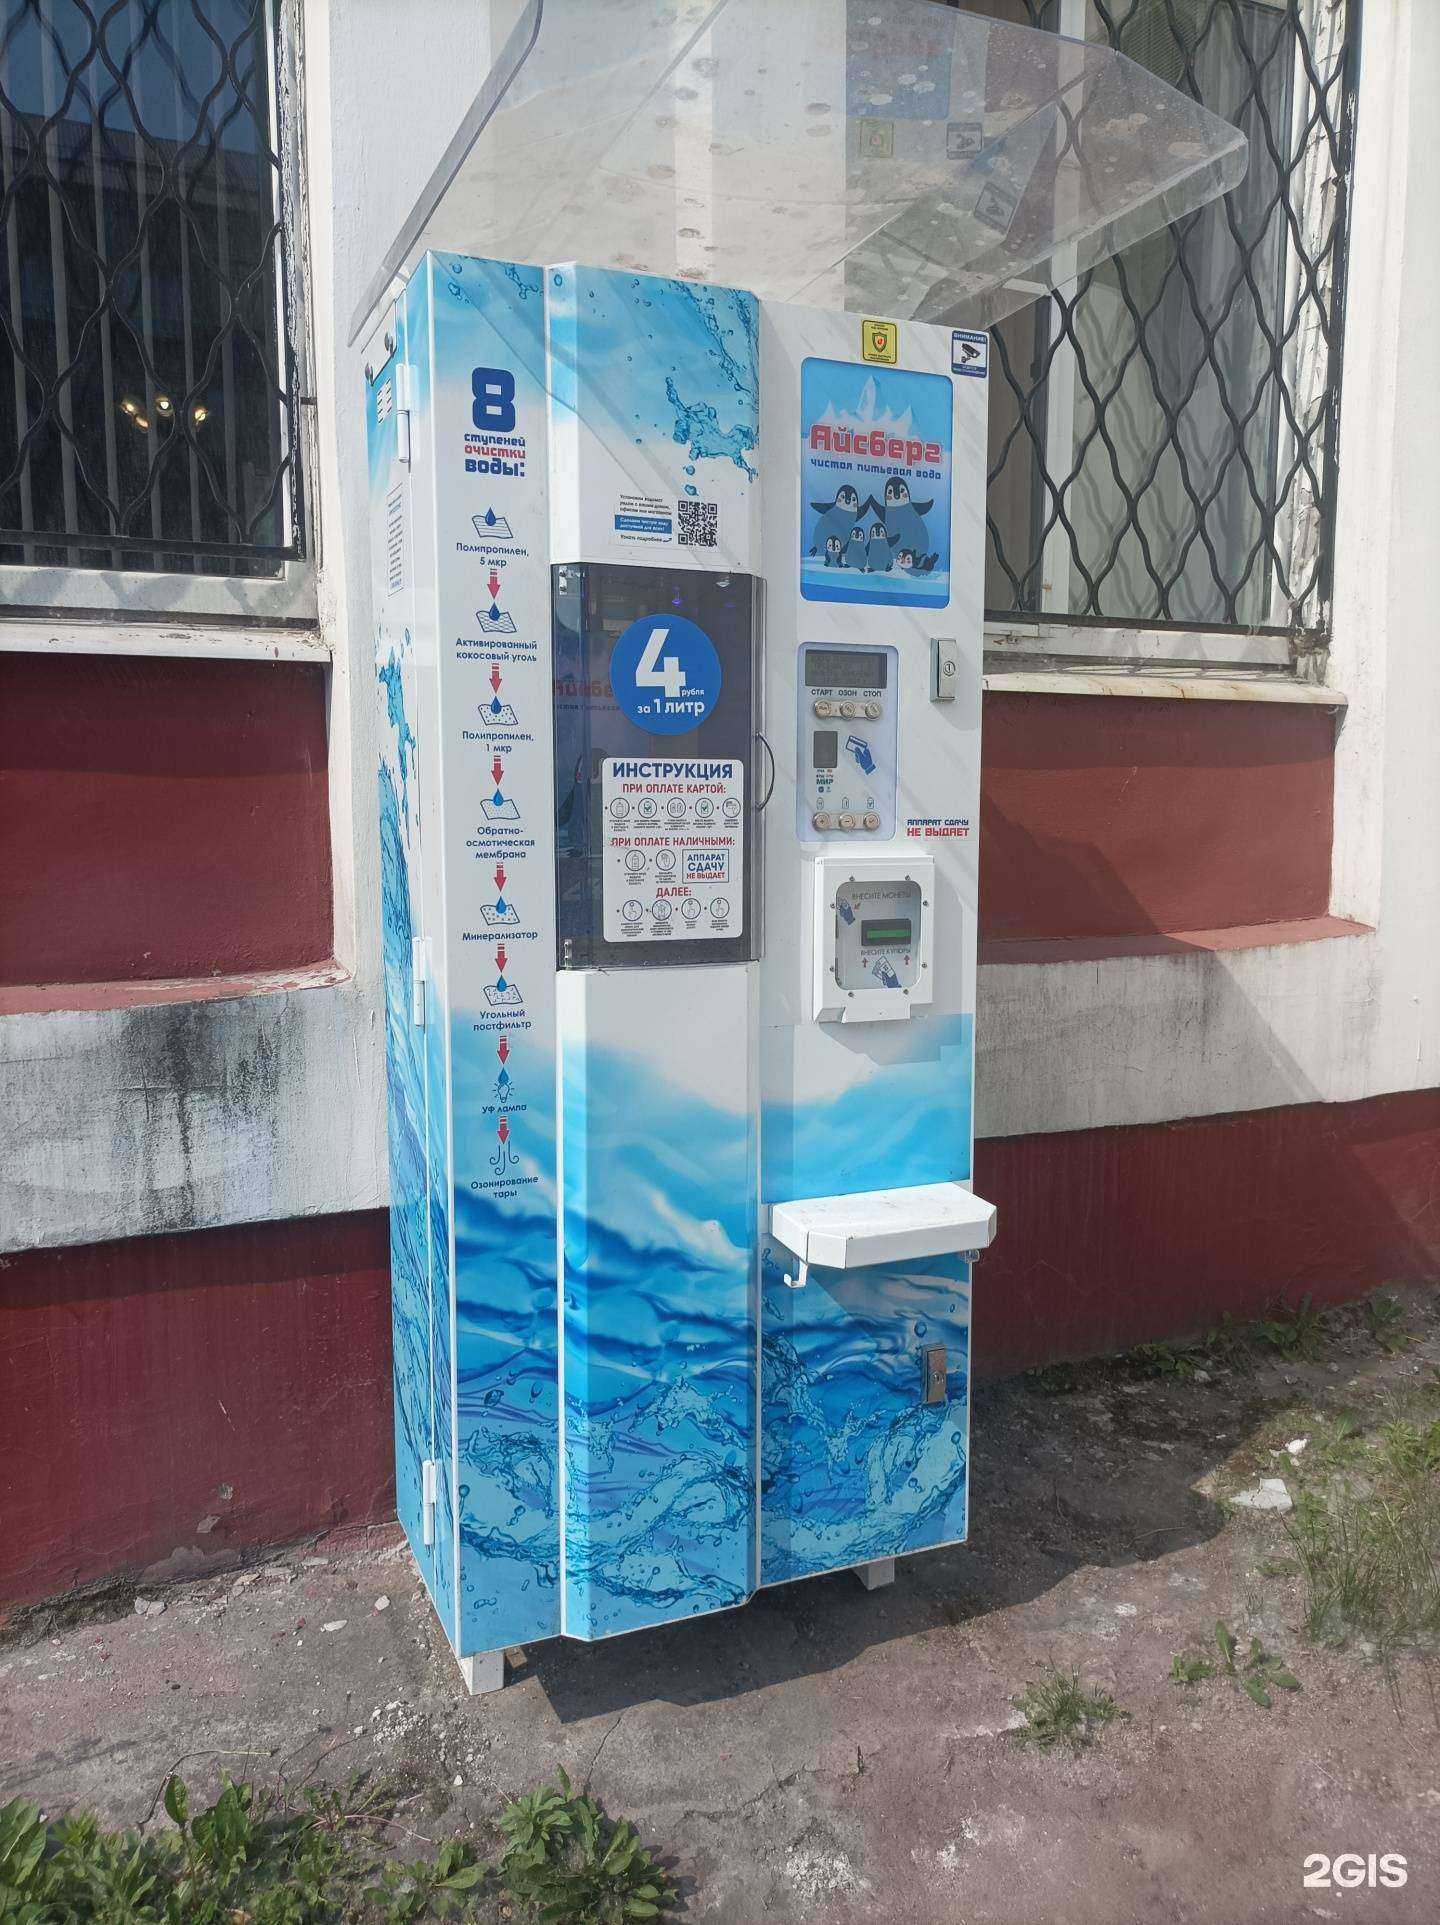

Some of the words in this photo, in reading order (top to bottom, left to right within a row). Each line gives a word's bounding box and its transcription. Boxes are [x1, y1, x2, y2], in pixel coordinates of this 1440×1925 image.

[472, 367, 516, 432] 8
[464, 433, 526, 447] ступеней
[810, 424, 942, 467] Айсберг
[464, 444, 526, 459] очистки
[465, 457, 525, 477] воды:
[810, 458, 853, 470] чистая
[857, 464, 912, 477] питьевая
[916, 469, 941, 480] вода
[456, 542, 529, 557] Полипропилен,
[479, 557, 485, 566] 5
[487, 559, 507, 568] мкр
[456, 638, 537, 650] Активированный
[456, 651, 510, 661] кокосовый
[511, 654, 537, 663] уголь
[635, 628, 686, 697] 4
[681, 687, 705, 697] рубля
[838, 689, 858, 697] ОЗОН
[863, 690, 882, 698] СТОП
[637, 705, 651, 714] за
[653, 698, 660, 714] 1
[664, 700, 705, 717] литр
[462, 731, 534, 742] Полипропилен,
[493, 745, 512, 754] мкр
[613, 762, 733, 780] ИНСТРУКЦИЯ
[622, 783, 643, 793] ПРИ
[646, 784, 684, 794] ОПЛАТЕ
[687, 782, 727, 794] КАРТОЙ:
[944, 819, 969, 827] СДАЧУ
[477, 827, 524, 837] Обратно-
[907, 827, 922, 837] НЕ
[925, 827, 970, 838] ВЫДАЕТ
[466, 839, 535, 848] осмотическая
[611, 837, 631, 847] ПРИ
[634, 837, 670, 847] ОПЛАТЕ
[673, 836, 735, 846] НАЛИЧНЫМИ:
[475, 850, 527, 860] мембрана
[687, 853, 726, 862] АППАРАТ
[687, 862, 725, 873] СДАЧУ
[686, 872, 697, 880] НЕ
[697, 872, 726, 880] ВЫДАЕТ
[655, 886, 692, 899] ДАЛЕЕ:
[462, 930, 538, 942] Минерализатор
[480, 1009, 526, 1020] Угольный
[473, 1020, 532, 1032] постфильтр
[498, 1104, 527, 1113] лампа
[470, 1175, 539, 1190] Озонирование
[493, 1189, 518, 1199] тары
